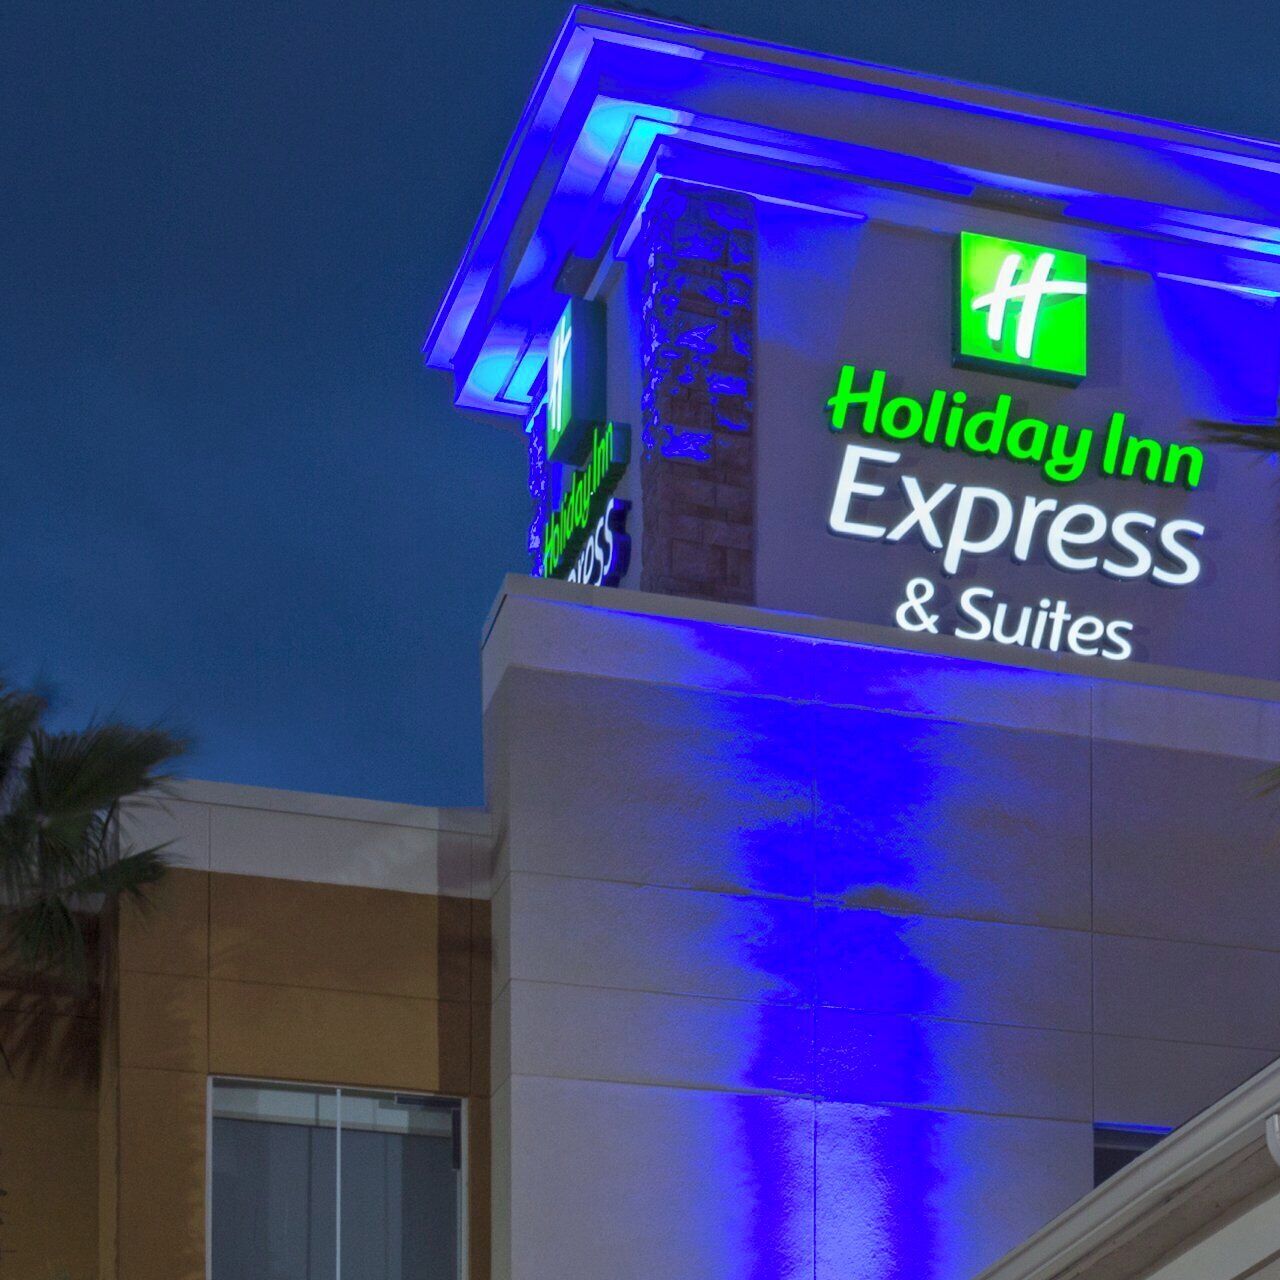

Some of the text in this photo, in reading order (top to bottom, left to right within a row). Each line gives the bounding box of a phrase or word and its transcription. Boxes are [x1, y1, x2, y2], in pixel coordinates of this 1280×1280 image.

[828, 365, 1204, 487] Holiday Inn
[543, 422, 614, 579] Holiday Inn
[829, 445, 1205, 585] Express
[896, 577, 1134, 661] & Suites
